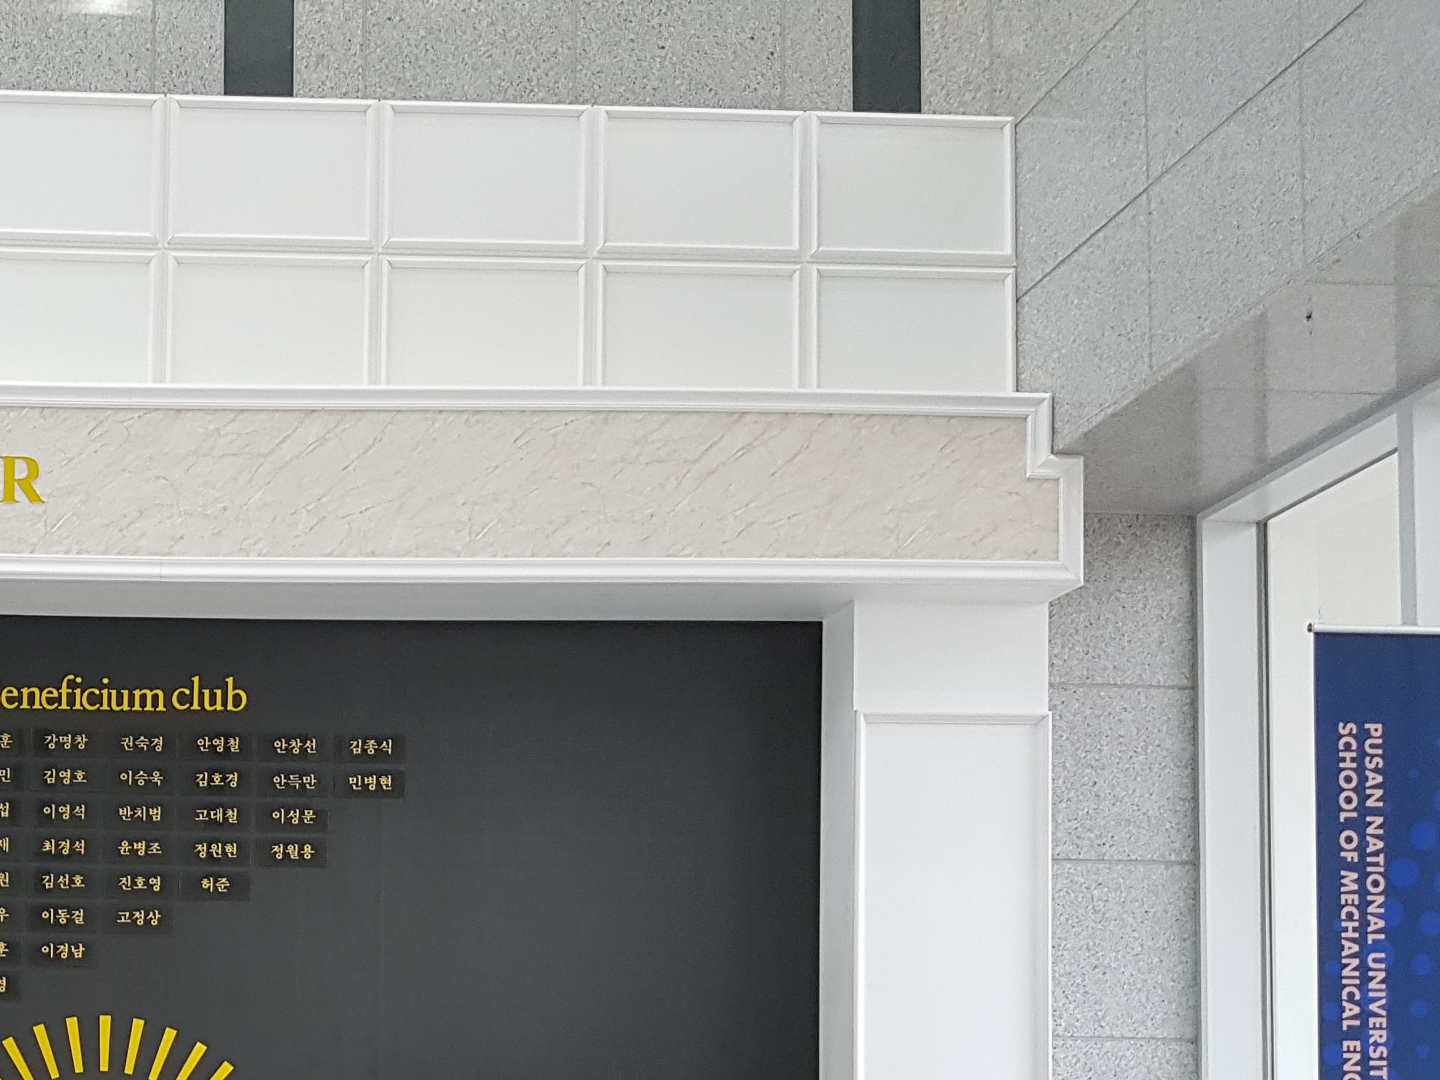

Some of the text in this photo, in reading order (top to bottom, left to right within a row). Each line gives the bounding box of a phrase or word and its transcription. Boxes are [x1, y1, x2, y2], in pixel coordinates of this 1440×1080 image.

[171, 676, 248, 712] club
[44, 734, 89, 750] 강명창
[120, 736, 163, 752] 권숙경
[196, 736, 240, 752] 안영철
[273, 738, 317, 755] 안창선
[348, 739, 393, 755] 김종식
[1338, 721, 1358, 822] SCHOOL
[1364, 723, 1383, 807] PUSAN
[43, 769, 88, 785] 김영호
[119, 770, 164, 786] 이승욱
[194, 772, 239, 788] 김호경
[272, 774, 318, 790] 안득만
[348, 774, 393, 791] 민병현
[43, 804, 86, 820] 이영석
[118, 806, 161, 821] 반치범
[194, 808, 239, 824] 고대철
[271, 808, 317, 825] 이성문
[41, 839, 85, 855] 최경석
[117, 840, 162, 856] 윤병조
[193, 842, 238, 858] 정원현
[1339, 830, 1358, 862] OF
[41, 874, 85, 889] 김선호
[118, 875, 161, 892] 진호영
[200, 877, 231, 892] 허준
[1365, 816, 1386, 945] NATIONAL
[41, 909, 85, 925] 이동걸
[116, 909, 162, 926] 고정상
[41, 943, 85, 959] 이경남
[1340, 870, 1361, 1031] MECHANICAL
